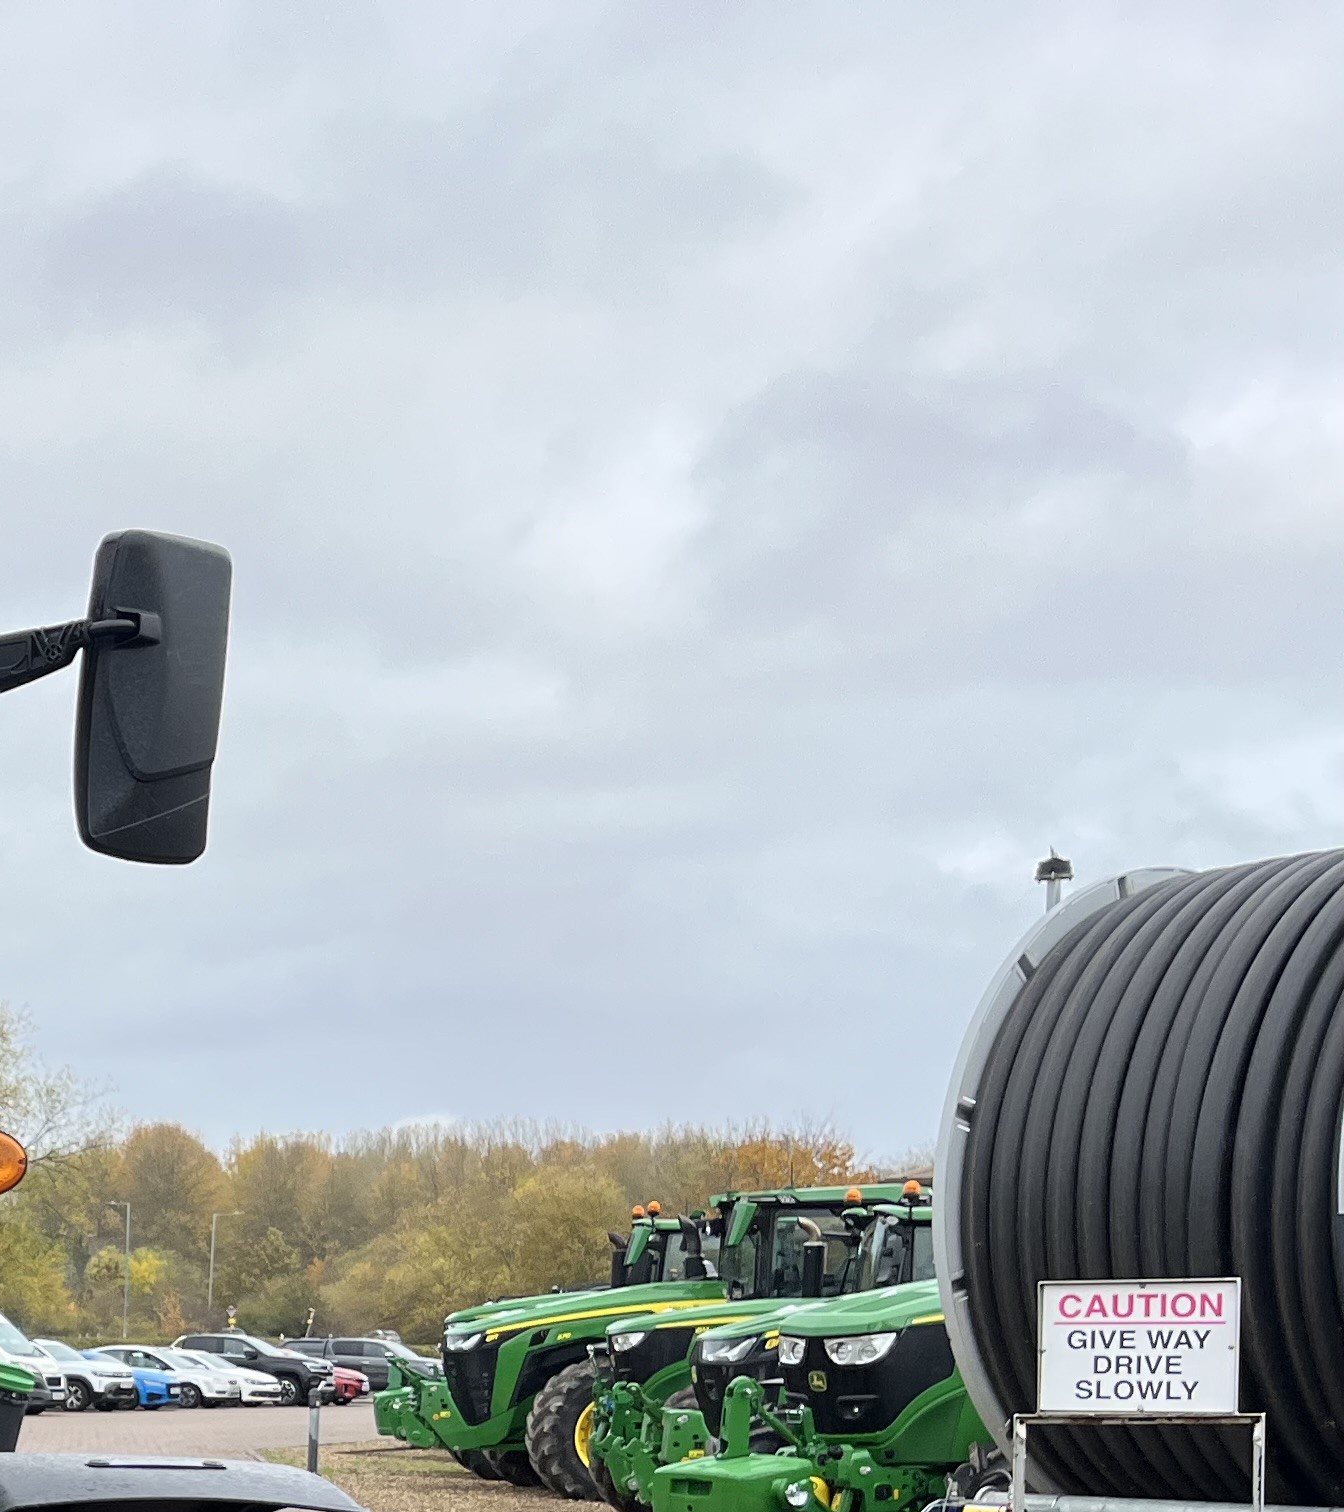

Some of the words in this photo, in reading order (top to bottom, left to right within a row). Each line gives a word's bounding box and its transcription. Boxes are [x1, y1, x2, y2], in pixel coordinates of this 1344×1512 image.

[1058, 1292, 1224, 1319] CAUTION
[1067, 1329, 1136, 1350] GIVE
[1147, 1329, 1212, 1350] WAY
[1093, 1355, 1183, 1375] DRIVE
[1075, 1380, 1200, 1401] SLOWLY
